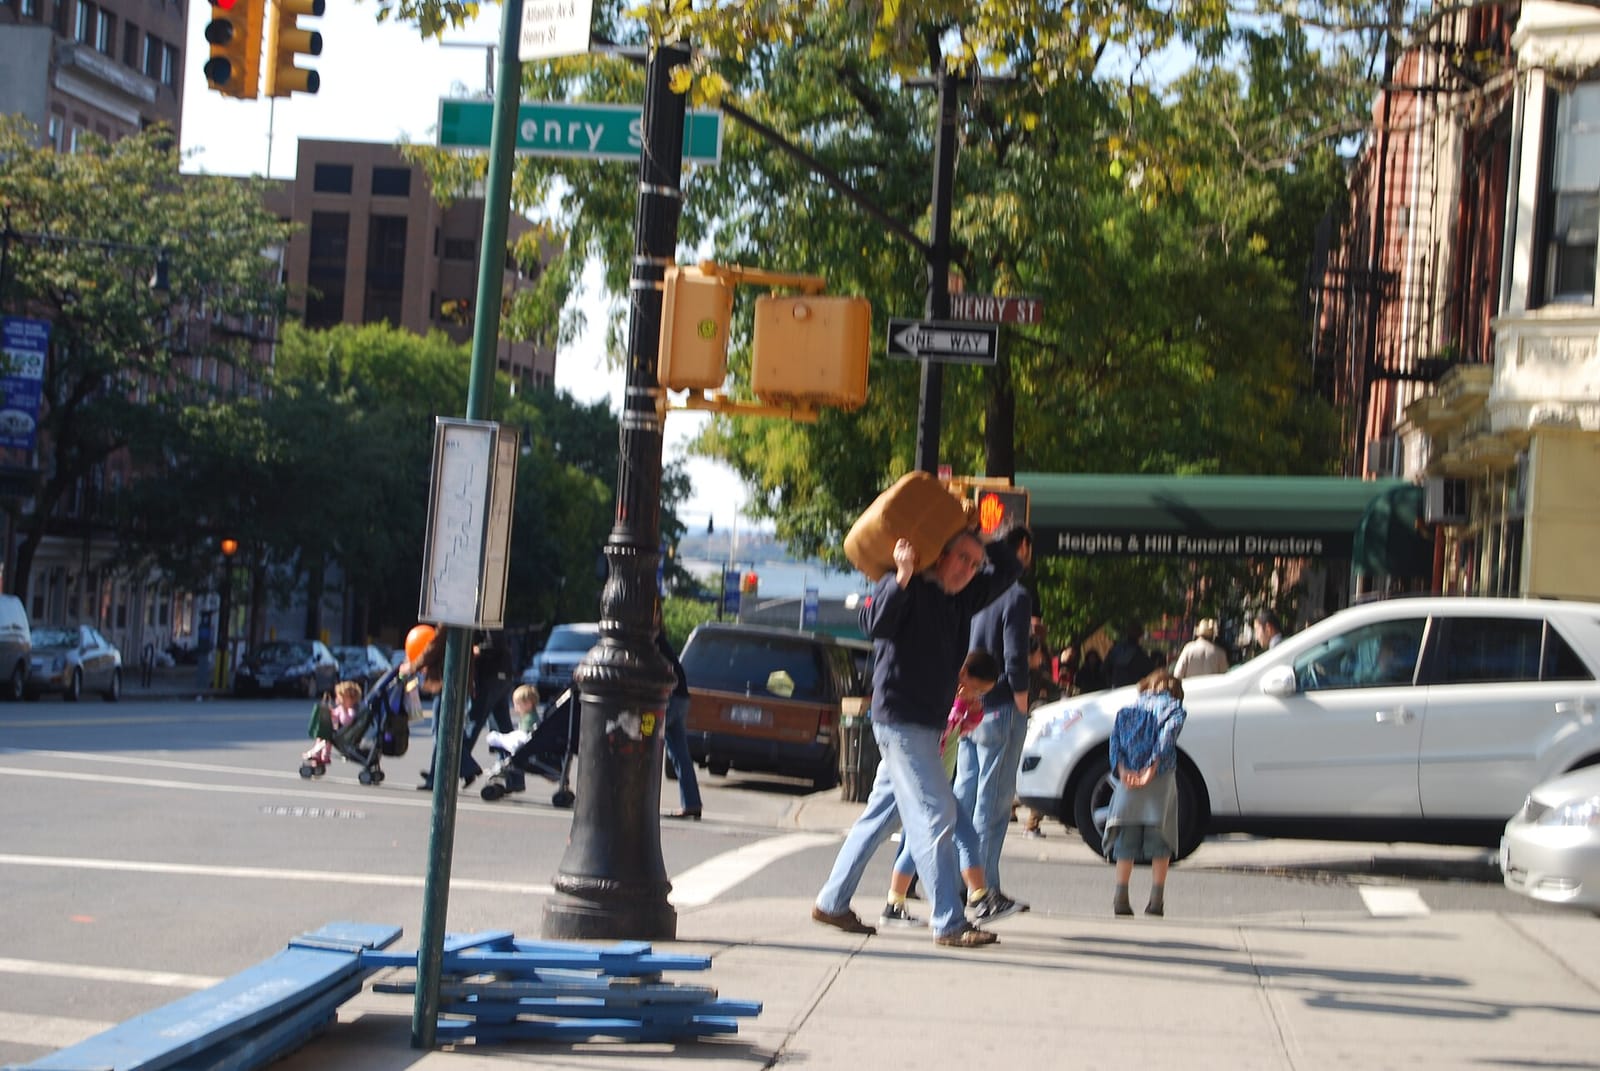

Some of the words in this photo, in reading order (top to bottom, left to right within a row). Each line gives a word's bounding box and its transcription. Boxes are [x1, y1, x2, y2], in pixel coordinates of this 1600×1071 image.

[520, 117, 605, 151] enry
[953, 296, 1006, 322] HENRY
[1017, 301, 1036, 323] ST
[905, 331, 935, 349] ONE
[951, 334, 982, 353] WAY
[1058, 532, 1122, 554] Heights
[1127, 534, 1139, 551] &
[1145, 534, 1172, 552] Hill
[1177, 535, 1239, 553] Funeral
[1245, 535, 1323, 554] Directors
